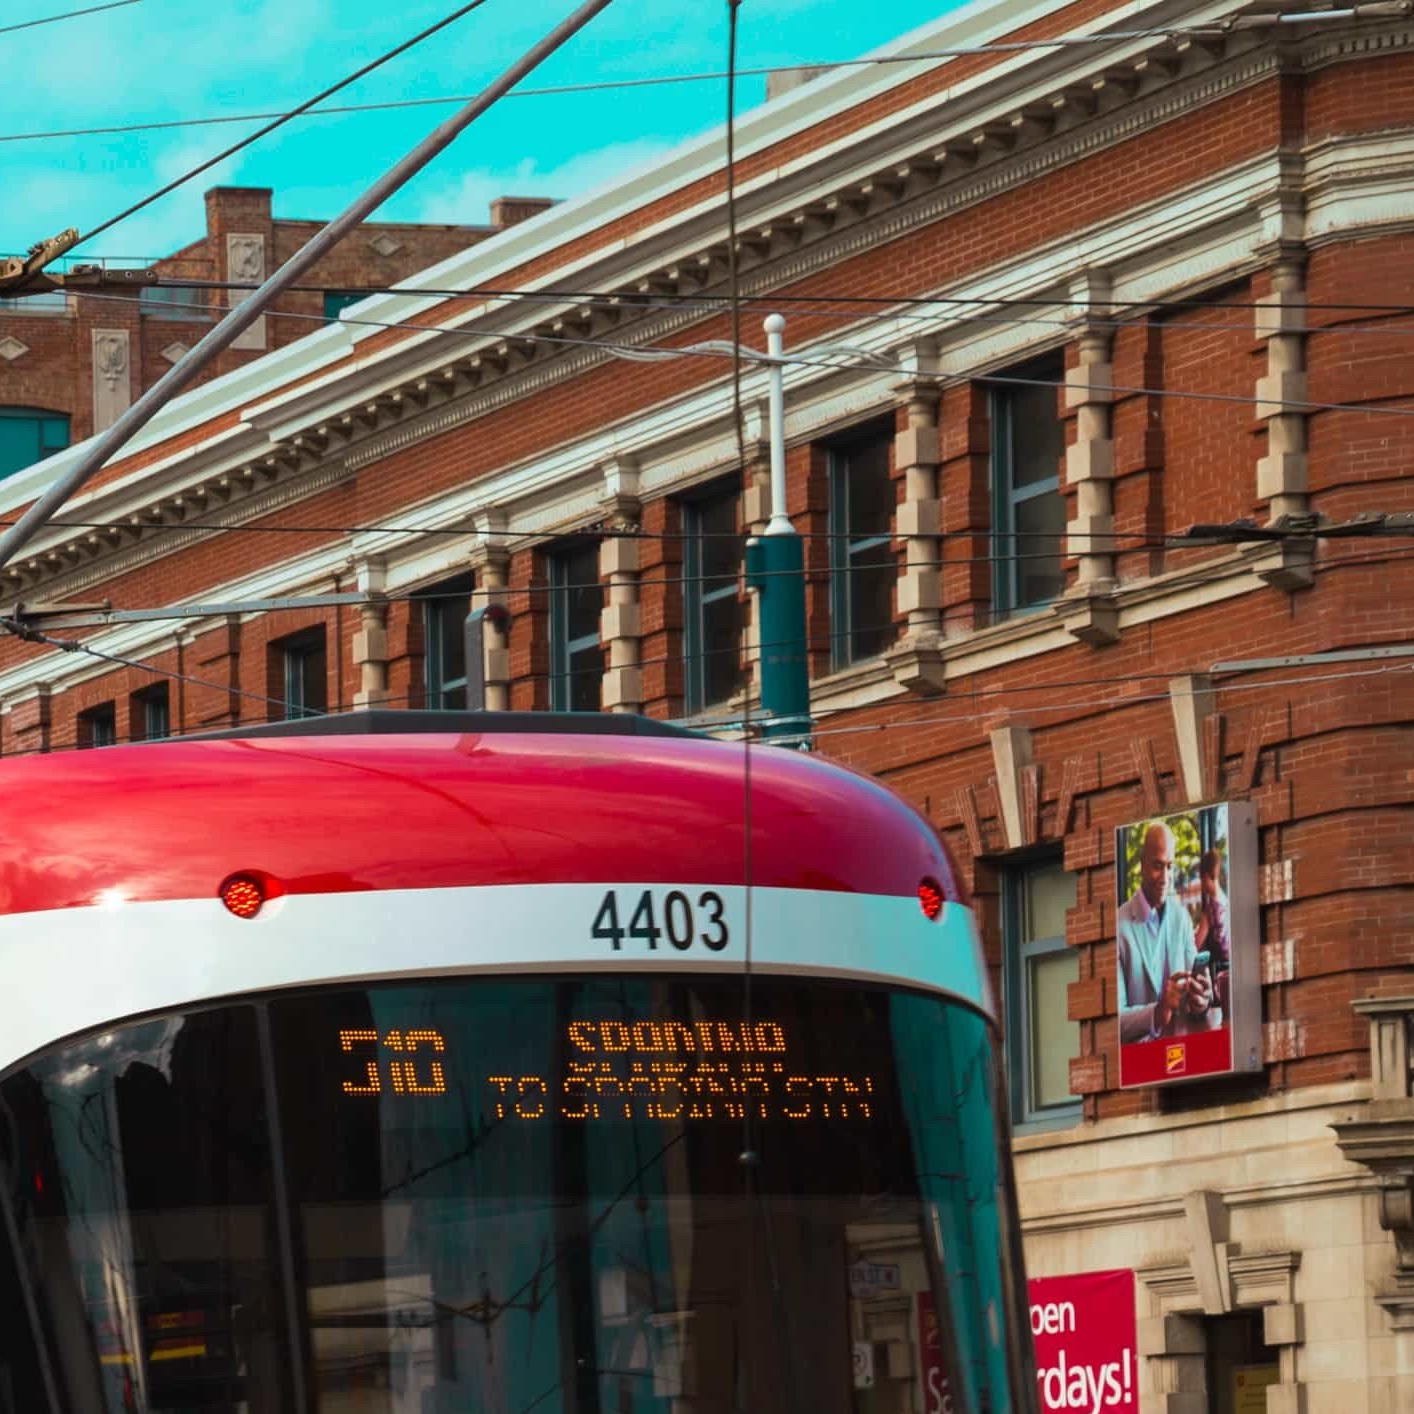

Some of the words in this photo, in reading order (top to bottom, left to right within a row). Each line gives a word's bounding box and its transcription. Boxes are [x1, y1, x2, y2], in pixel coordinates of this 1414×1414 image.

[591, 889, 729, 951] 4403
[338, 1029, 447, 1093] 510
[486, 1076, 548, 1119] TO
